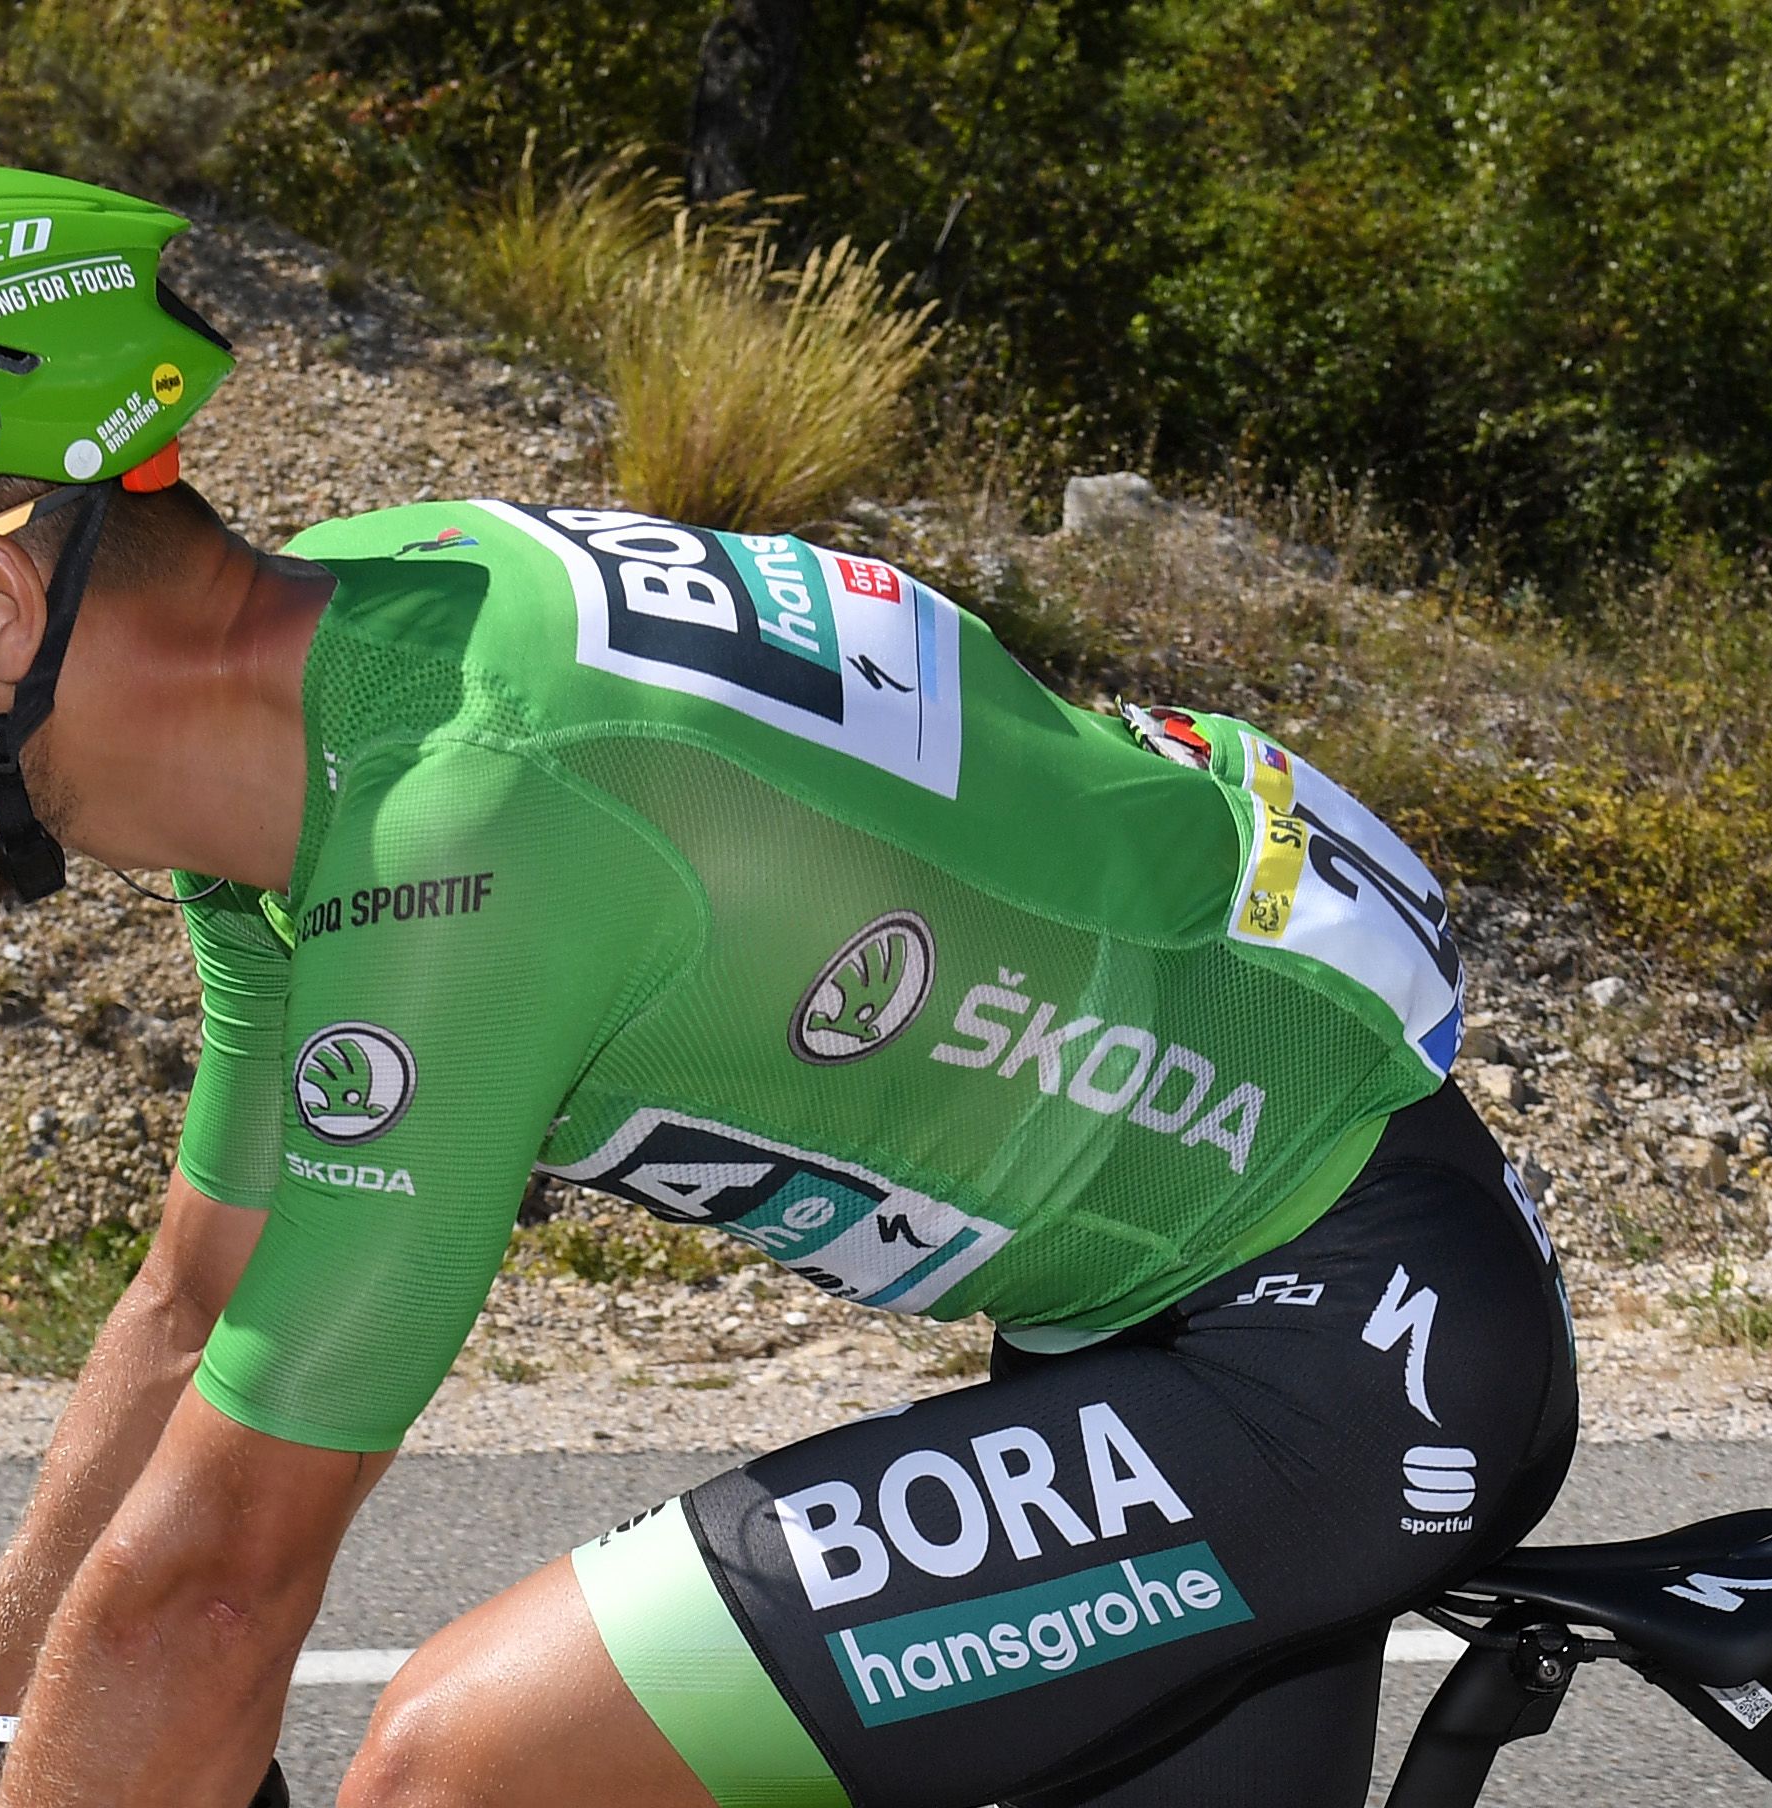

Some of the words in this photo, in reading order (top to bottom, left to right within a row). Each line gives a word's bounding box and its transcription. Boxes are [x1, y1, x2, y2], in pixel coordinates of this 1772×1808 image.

[25, 275, 71, 307] FOR
[69, 263, 136, 298] FOCUS
[95, 407, 127, 441] BAND
[125, 391, 142, 409] OF
[104, 398, 160, 455] BROTHERS
[350, 872, 495, 928] SPORTIF
[929, 964, 1267, 1176] ŠKODA
[284, 1152, 417, 1197] ŠKODA
[773, 1401, 1195, 1612] BORA
[1399, 1515, 1474, 1535] sportful
[839, 1558, 1223, 1706] hansgrohe
